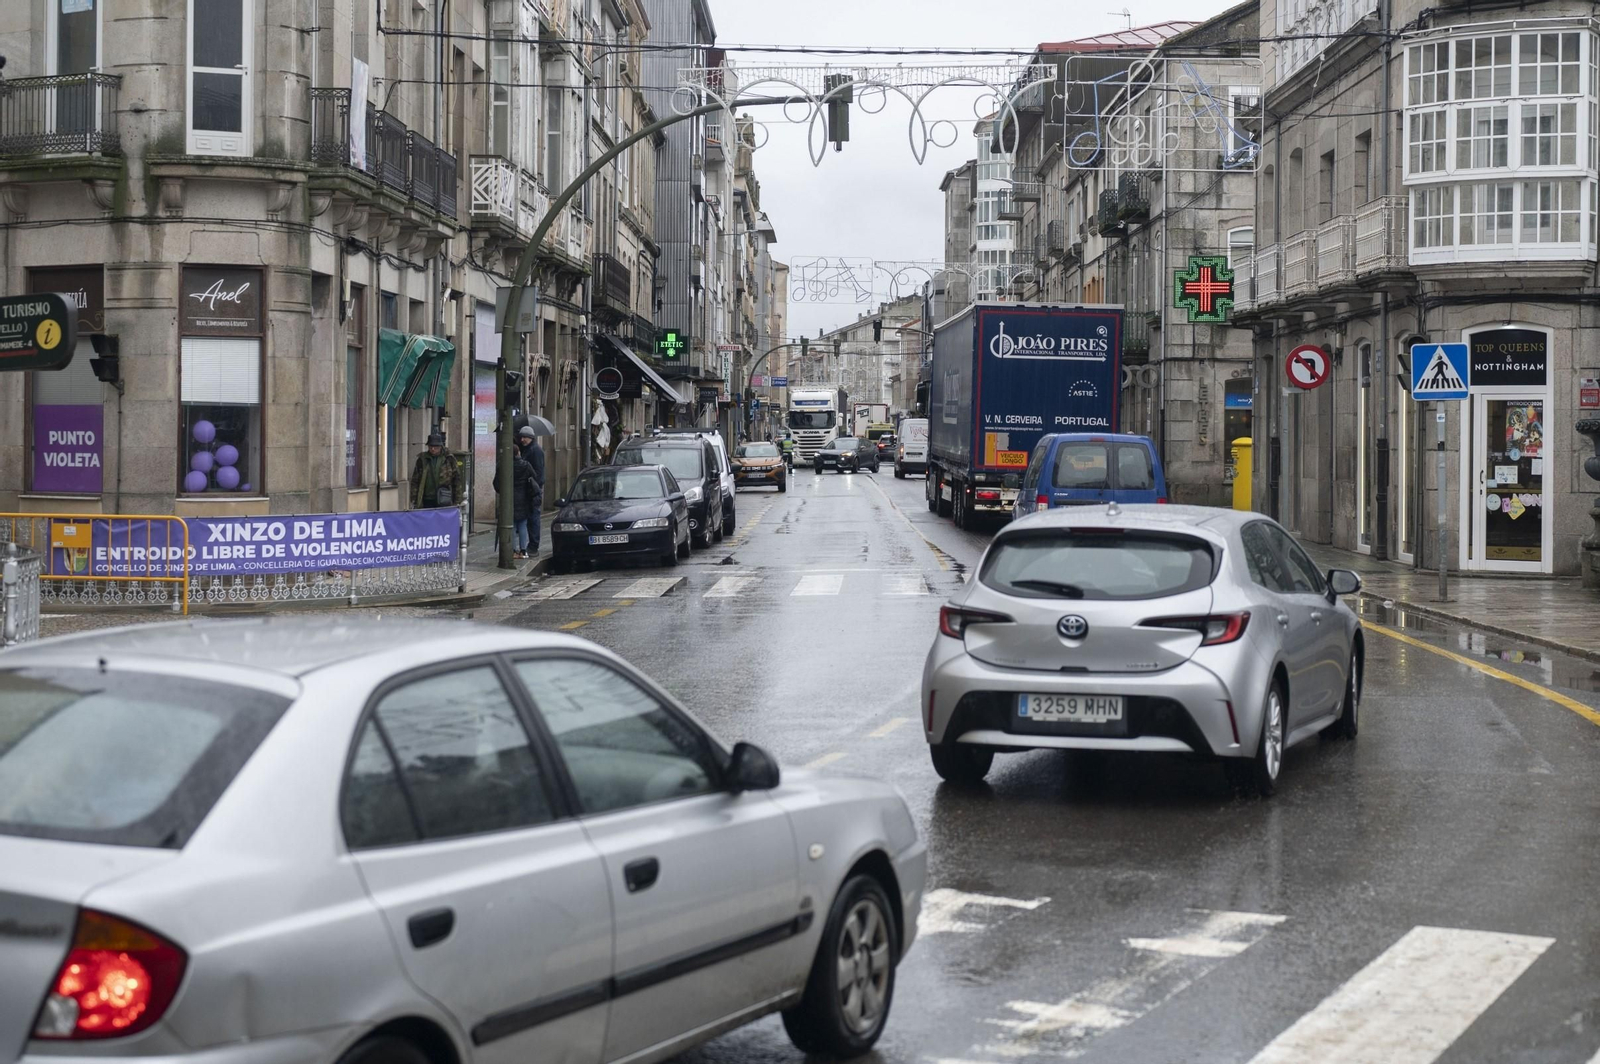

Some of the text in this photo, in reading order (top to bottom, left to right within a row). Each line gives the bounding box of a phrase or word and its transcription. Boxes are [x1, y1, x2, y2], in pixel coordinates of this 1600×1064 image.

[189, 279, 250, 311] Anel
[2, 302, 51, 318] TURISMO
[1014, 334, 1108, 351] JOÃO PIRES
[1475, 342, 1545, 354] TOP QUEENS
[1506, 354, 1512, 362] &
[1474, 363, 1544, 371] NOTTINGHAM
[985, 415, 1043, 424] V. N. CERVEIRA
[1055, 416, 1109, 426] PORTUGAL
[49, 431, 95, 445] PUNTO
[43, 452, 100, 467] VIOLETA
[207, 518, 387, 542] XINZO DE LIMIA
[96, 534, 451, 561] ENTROIDO LIBRE DE VIOLENCIAS MACHISTAS
[96, 564, 147, 572] CONCELLO
[149, 564, 162, 572] DE
[164, 564, 193, 572] XINZO
[195, 563, 208, 571] DE
[210, 563, 236, 571] LIMIA
[243, 560, 302, 570] CONCELLERIA
[304, 560, 315, 568] DE
[317, 557, 362, 567] IGUALDADE
[375, 554, 416, 564] CONCELLERIA
[417, 553, 427, 561] DE
[1032, 696, 1118, 716] 3259 MHN
